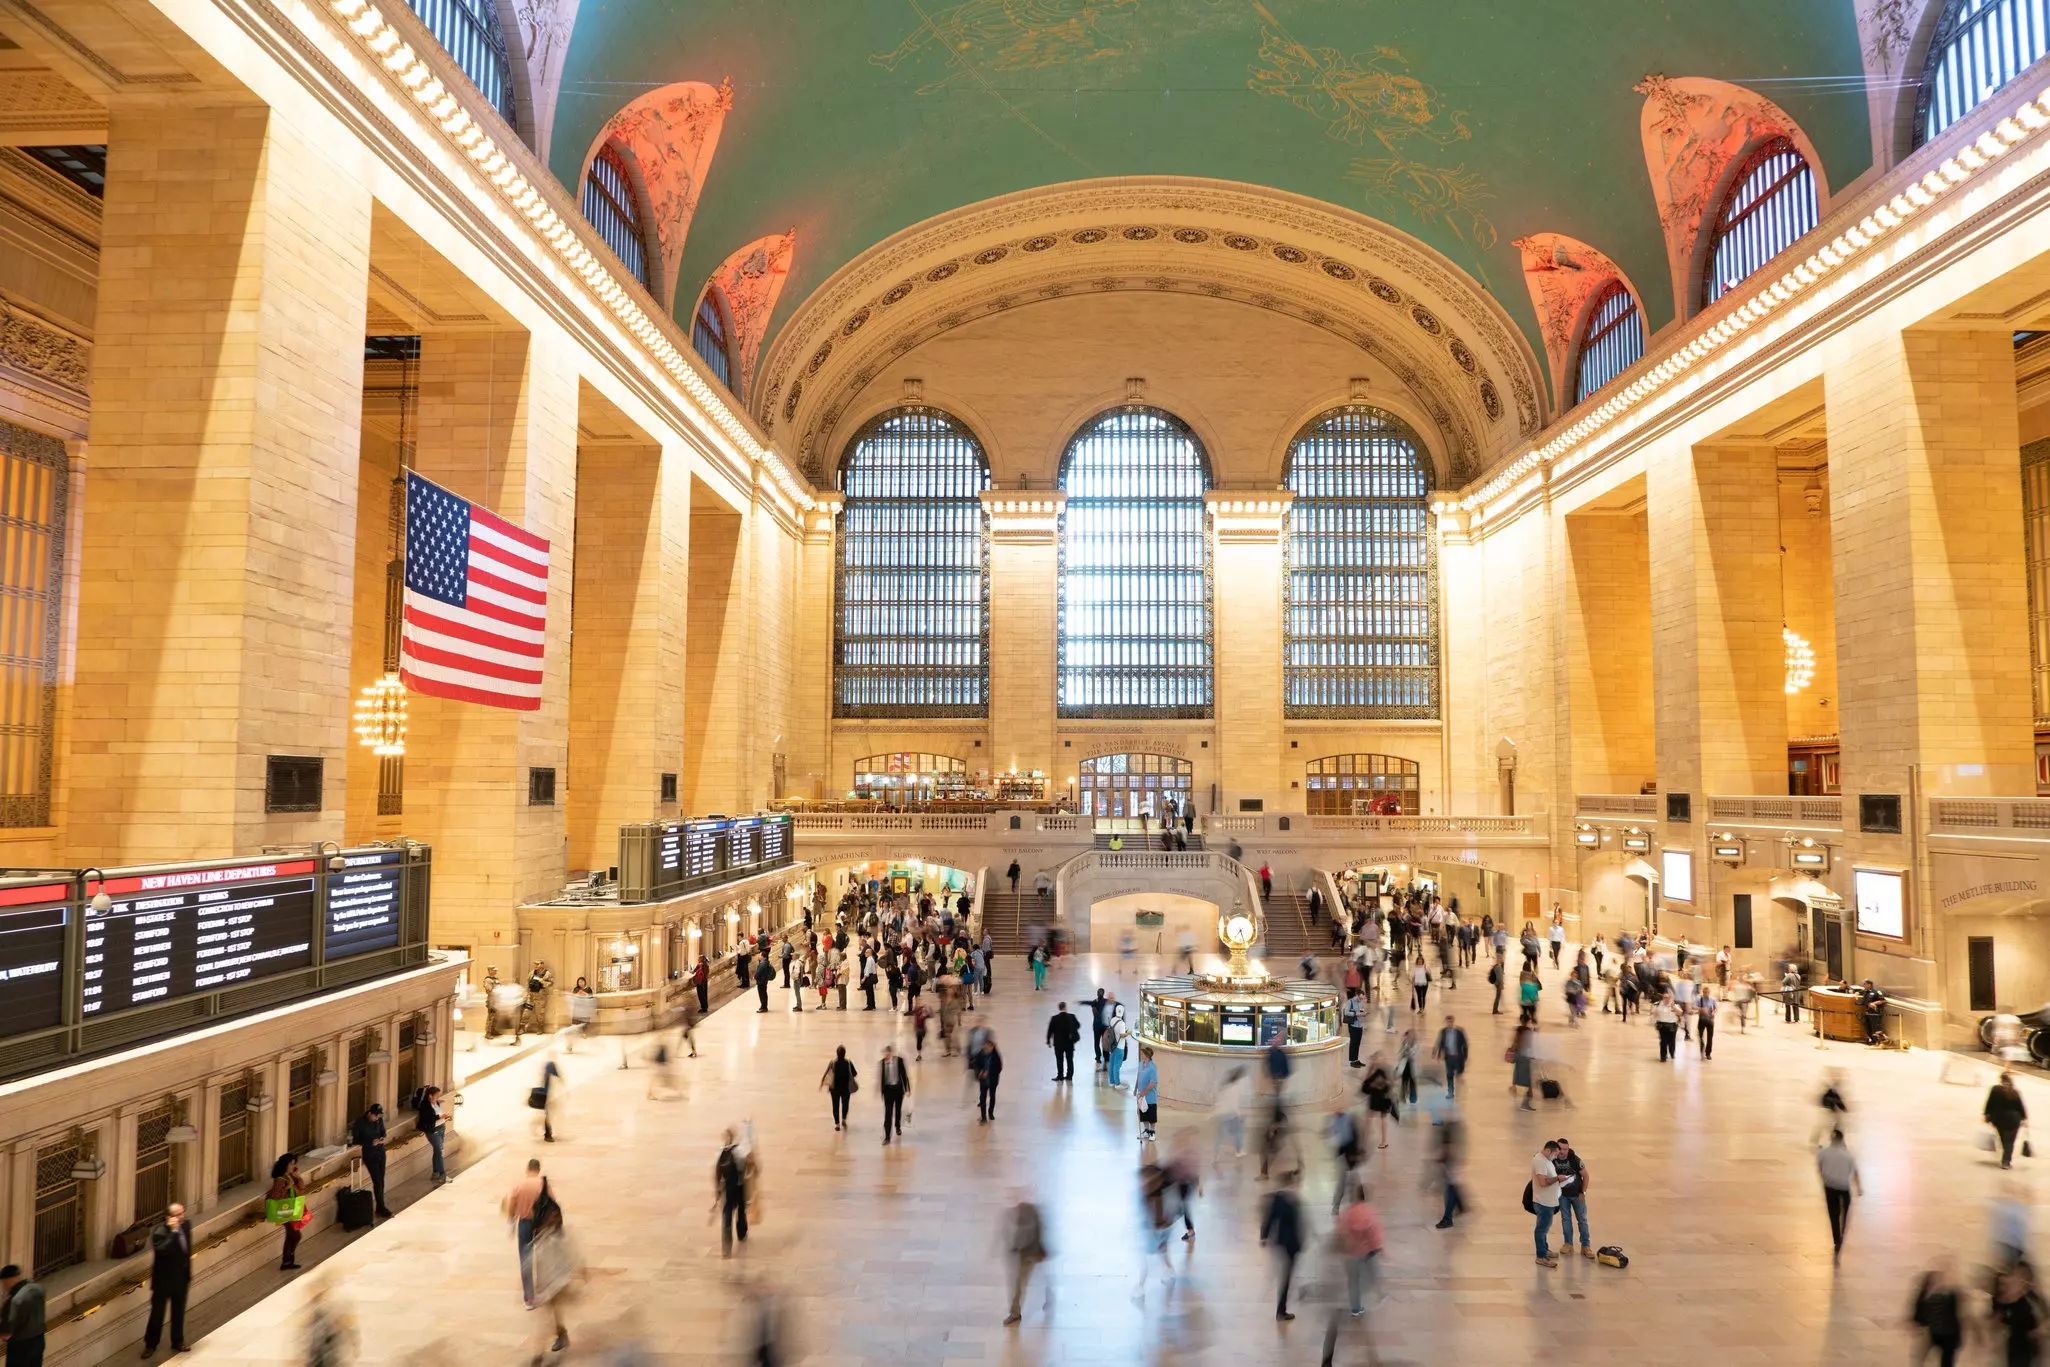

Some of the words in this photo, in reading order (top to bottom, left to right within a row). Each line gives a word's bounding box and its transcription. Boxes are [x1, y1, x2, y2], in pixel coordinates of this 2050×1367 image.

[831, 851, 870, 861] MACHINES
[1344, 858, 1369, 867] TICKET
[1371, 854, 1409, 863] MACHINES
[1432, 855, 1460, 863] TRACKS
[141, 876, 166, 890] NEW
[167, 870, 200, 887] HAVEN
[201, 868, 224, 883] LINE
[224, 865, 277, 880] DEPARTURES
[1941, 894, 1959, 907] THE
[1958, 884, 1992, 901] METLIFE
[1994, 880, 2038, 893] BUILDING
[135, 896, 184, 910] DESTINATION
[135, 927, 169, 940] STAMFORD
[238, 915, 252, 924] STOP
[197, 932, 228, 944] STAMFORD
[239, 927, 255, 937] STOP
[134, 957, 169, 971] STAMFORD
[237, 941, 252, 951] STOP
[9, 961, 59, 978] WATERBURY
[132, 987, 168, 1002] STAMFORD
[235, 968, 251, 978] STOP
